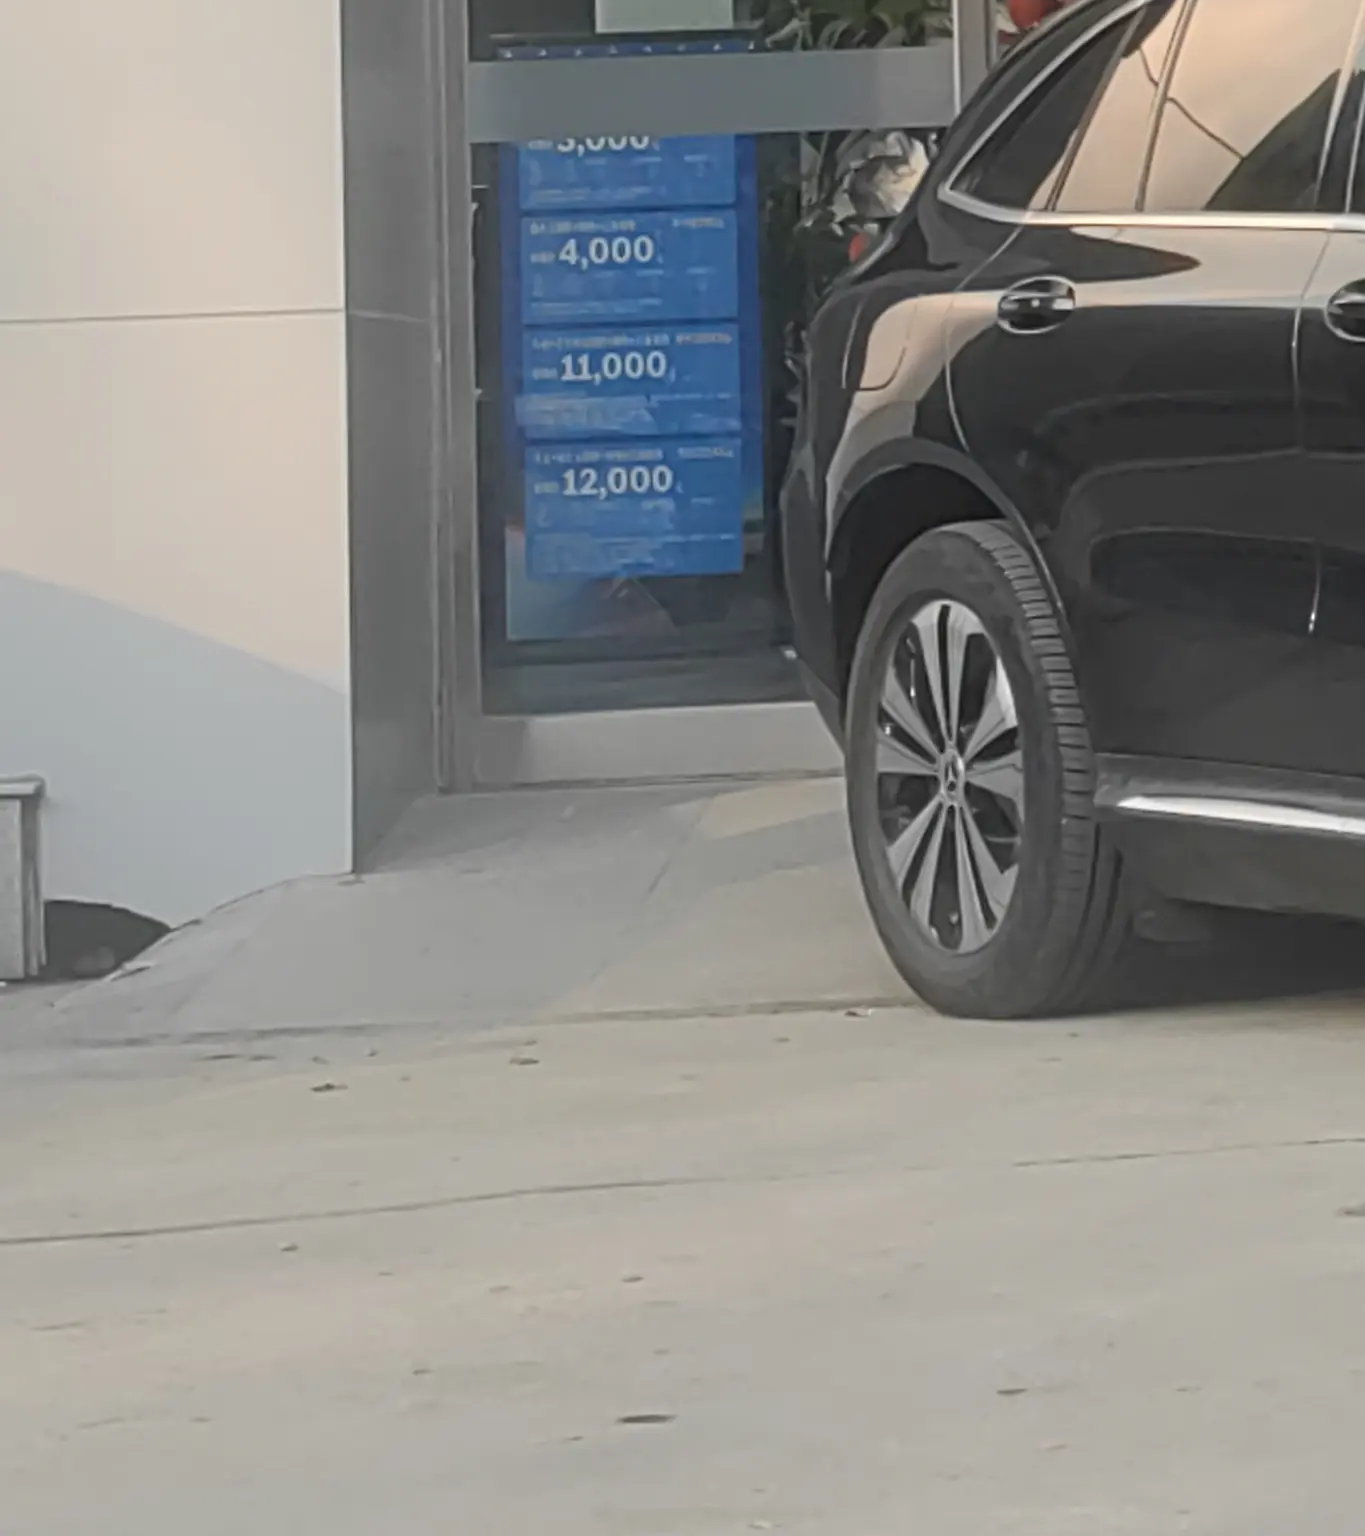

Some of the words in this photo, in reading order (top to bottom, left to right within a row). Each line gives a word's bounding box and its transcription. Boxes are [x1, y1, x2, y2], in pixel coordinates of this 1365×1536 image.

[558, 234, 655, 272] 4,000
[560, 350, 668, 386] 11,000
[561, 465, 674, 500] 12,000
